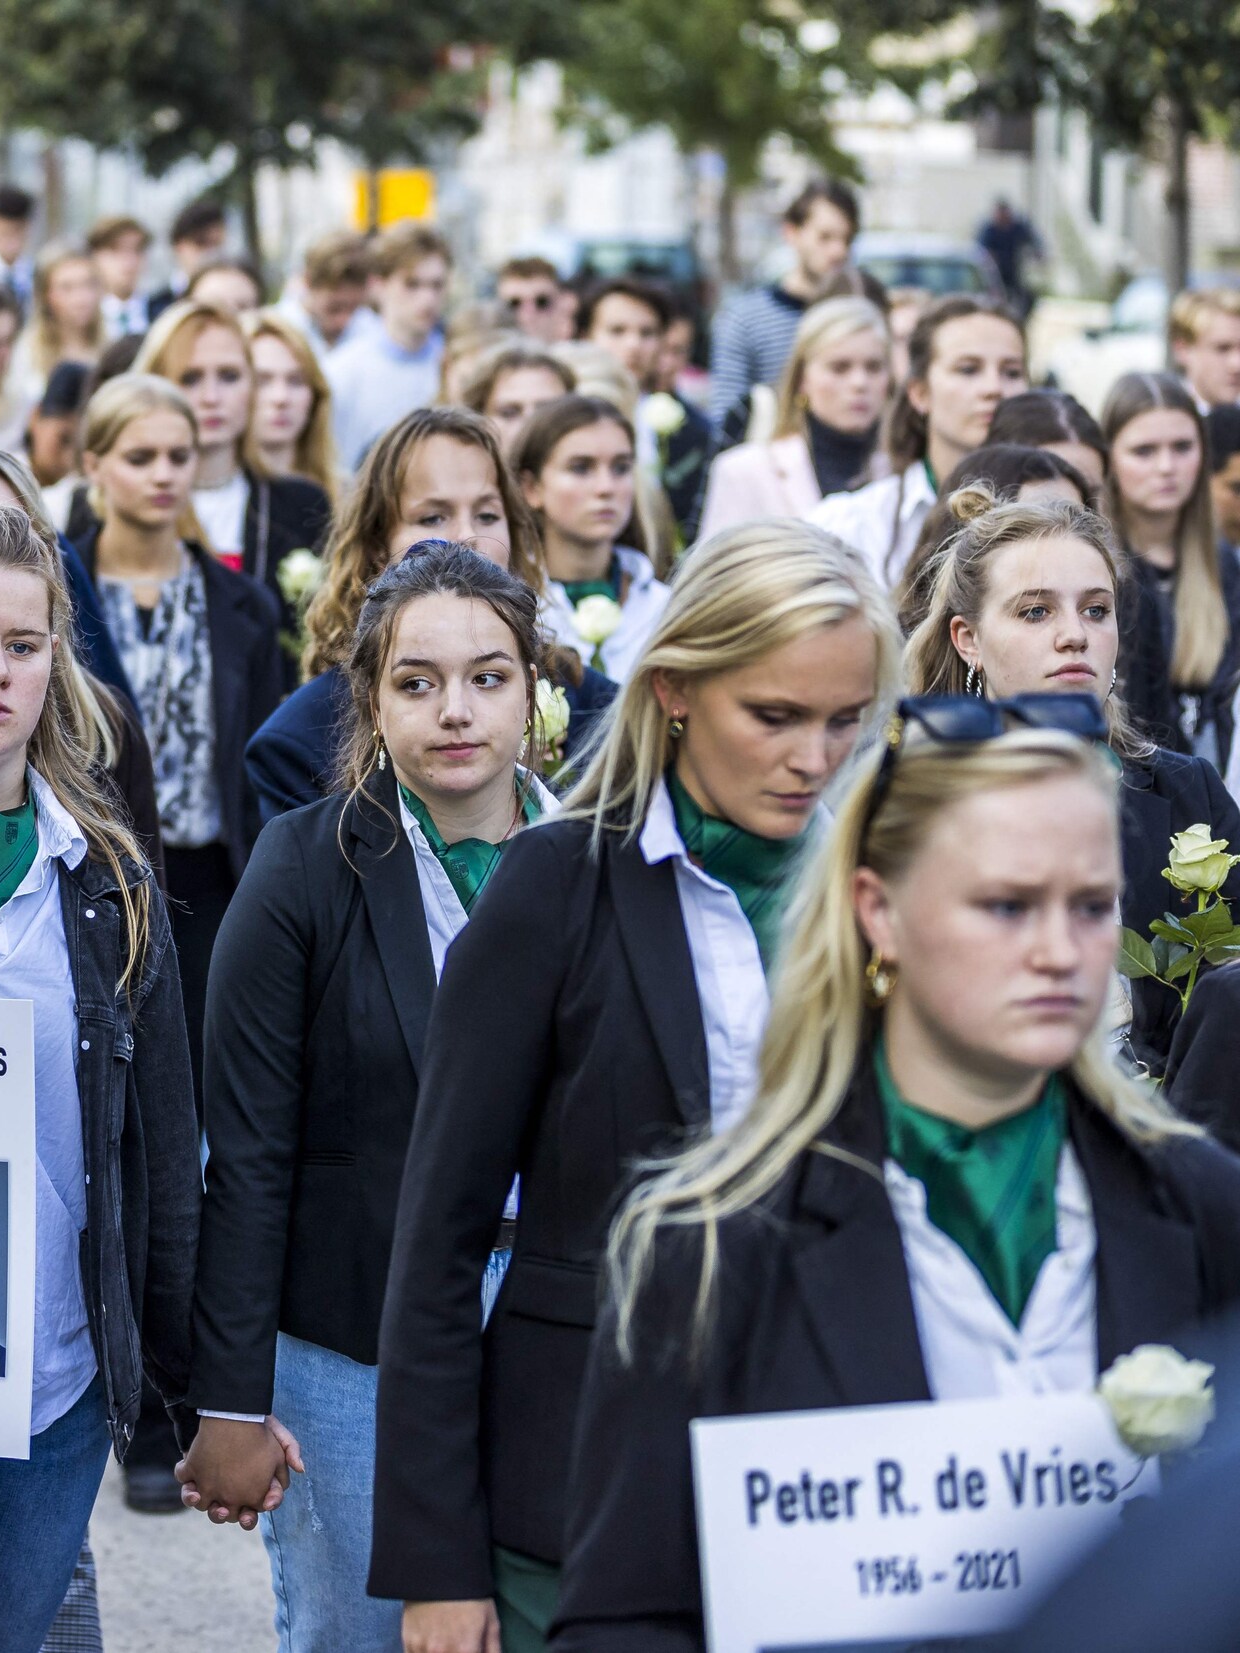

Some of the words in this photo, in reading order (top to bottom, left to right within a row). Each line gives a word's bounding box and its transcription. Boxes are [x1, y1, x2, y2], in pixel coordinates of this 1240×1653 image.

[744, 1467, 862, 1527] Peter
[876, 1459, 920, 1516] R.
[935, 1454, 988, 1512] de
[1000, 1447, 1118, 1508] Vries
[855, 1556, 923, 1595] 1956
[955, 1549, 1023, 1592] 2021
